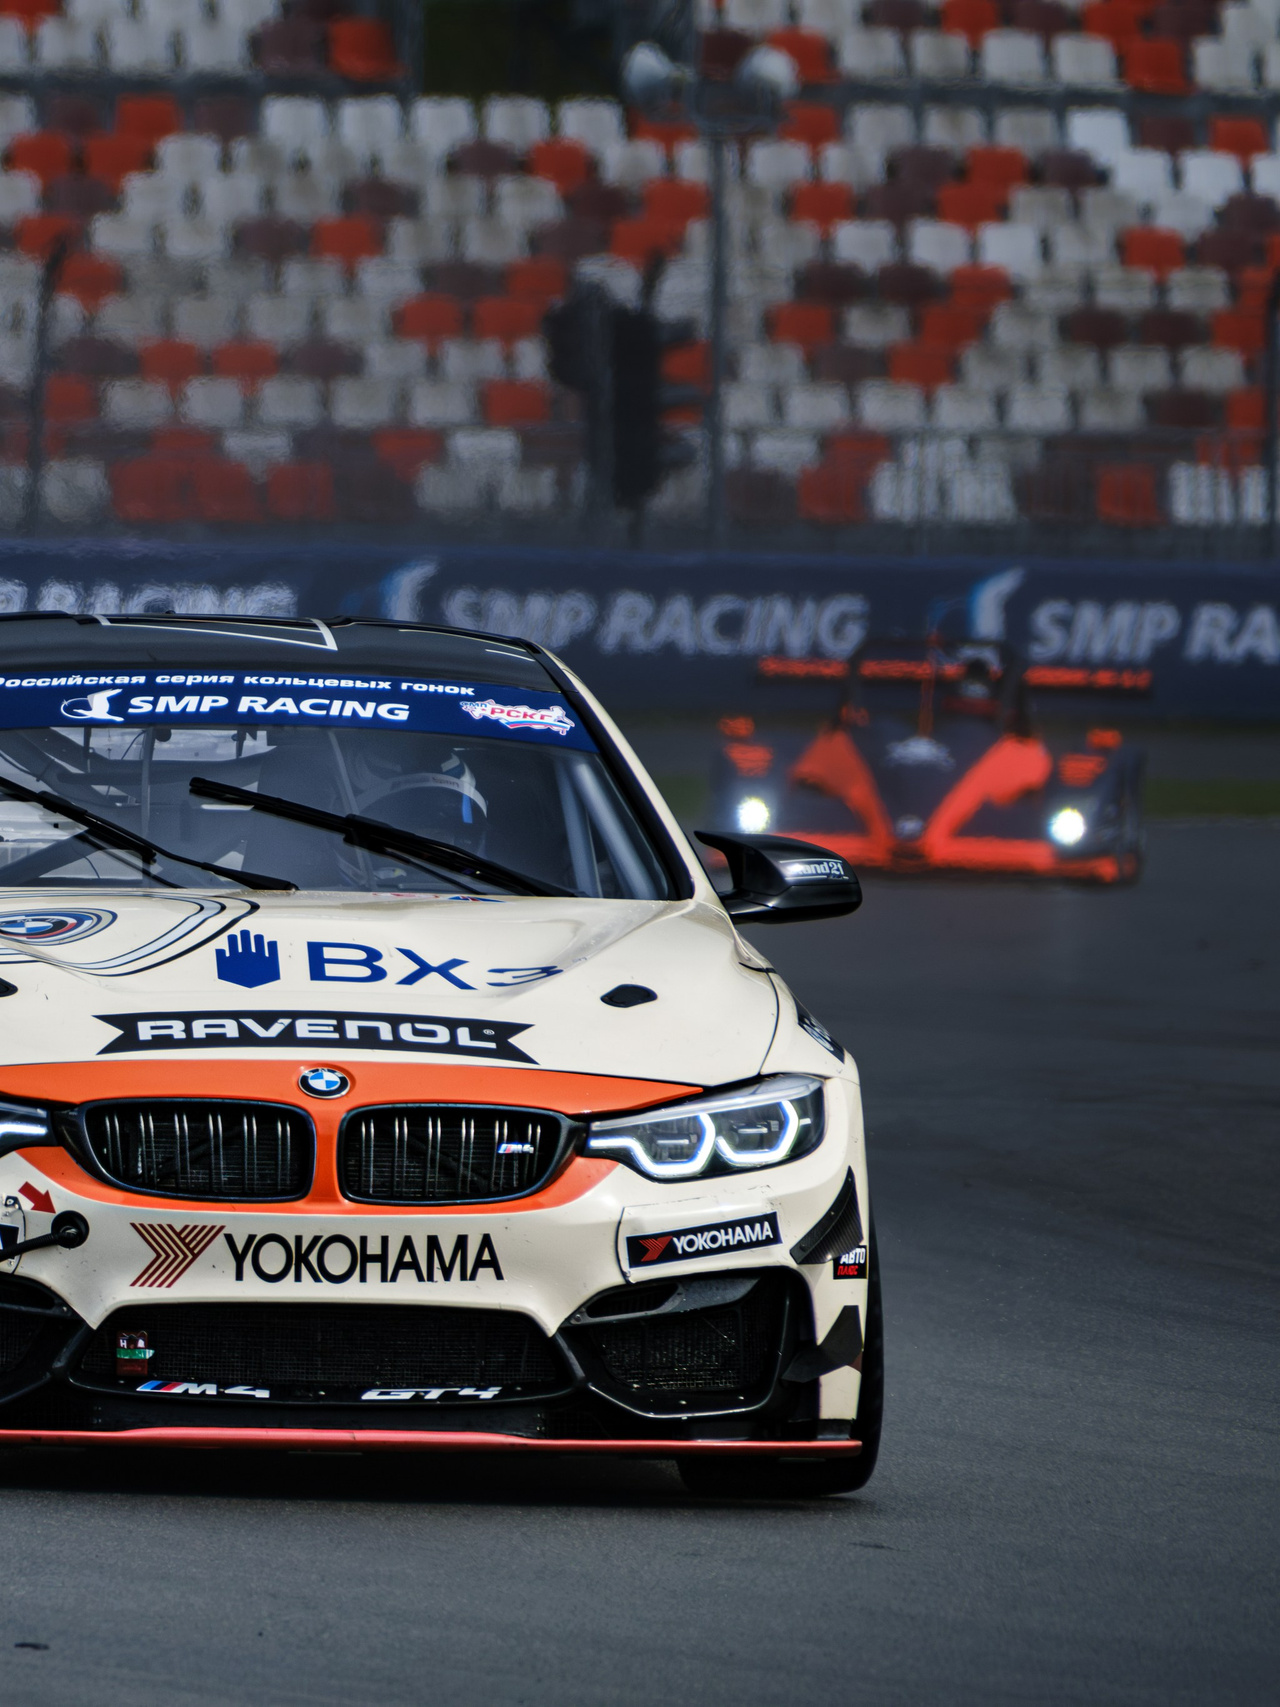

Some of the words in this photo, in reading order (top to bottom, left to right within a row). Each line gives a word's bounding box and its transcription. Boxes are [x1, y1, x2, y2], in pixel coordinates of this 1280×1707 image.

[598, 588, 868, 658] RACING
[1028, 600, 1181, 663] SMP
[155, 674, 235, 686] серия
[243, 676, 392, 690] кольцевых
[400, 682, 475, 696] гонок
[127, 695, 229, 713] SMP
[237, 695, 410, 721] RACING
[490, 706, 553, 720] РСКГ
[306, 940, 564, 991] BX3
[673, 1221, 774, 1255] YOKOHAMA
[222, 1231, 504, 1284] YOKOHAMA
[166, 1381, 270, 1399] M4
[360, 1386, 503, 1401] GT4
